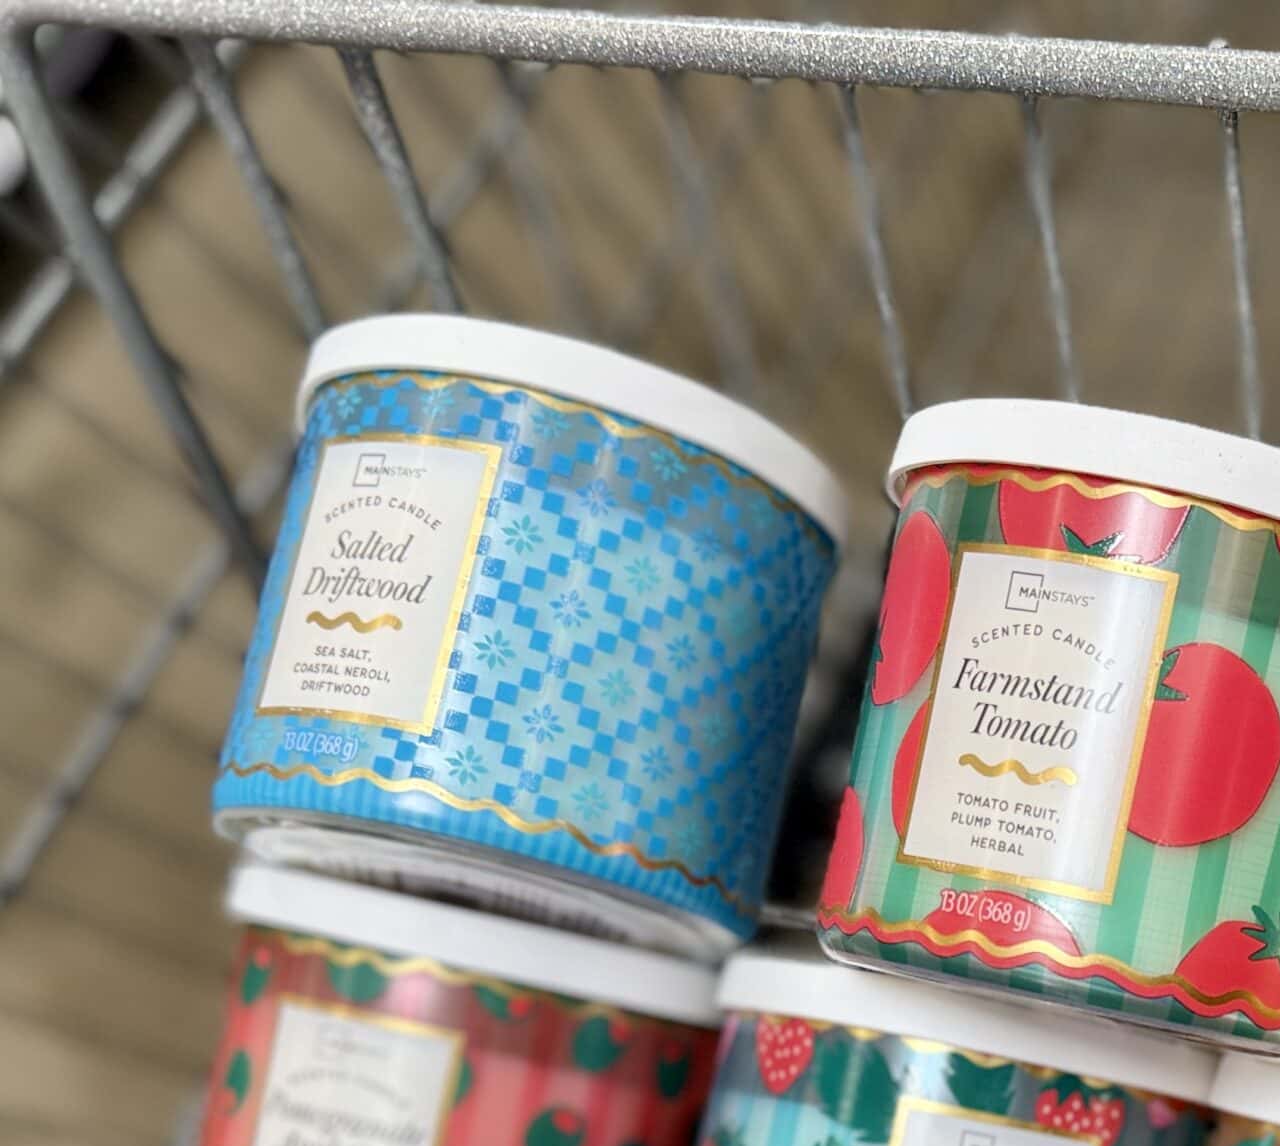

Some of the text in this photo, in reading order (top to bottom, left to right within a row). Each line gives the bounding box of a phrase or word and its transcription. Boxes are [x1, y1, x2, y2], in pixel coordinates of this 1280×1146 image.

[324, 495, 442, 531] SCENTED CANDLE
[331, 529, 415, 565] Salted
[303, 566, 433, 605] Driftwood
[1019, 586, 1089, 608] MAINSTAYS
[314, 645, 372, 663] SEA SALT,
[971, 623, 1115, 672] SCENTED CANDLE
[293, 662, 391, 683] COASTAL NEROLI,
[301, 680, 370, 697] DRIFTWOOD
[952, 657, 1123, 715] Farmstand
[970, 702, 1078, 750] Tomato
[958, 793, 1060, 824] TOMATO FRUIT,
[952, 812, 1056, 844] PLUMP TOMATO,
[971, 837, 1024, 856] HERBAL
[957, 892, 978, 917] OZ
[978, 897, 1011, 924] (368
[1013, 907, 1031, 932] g)
